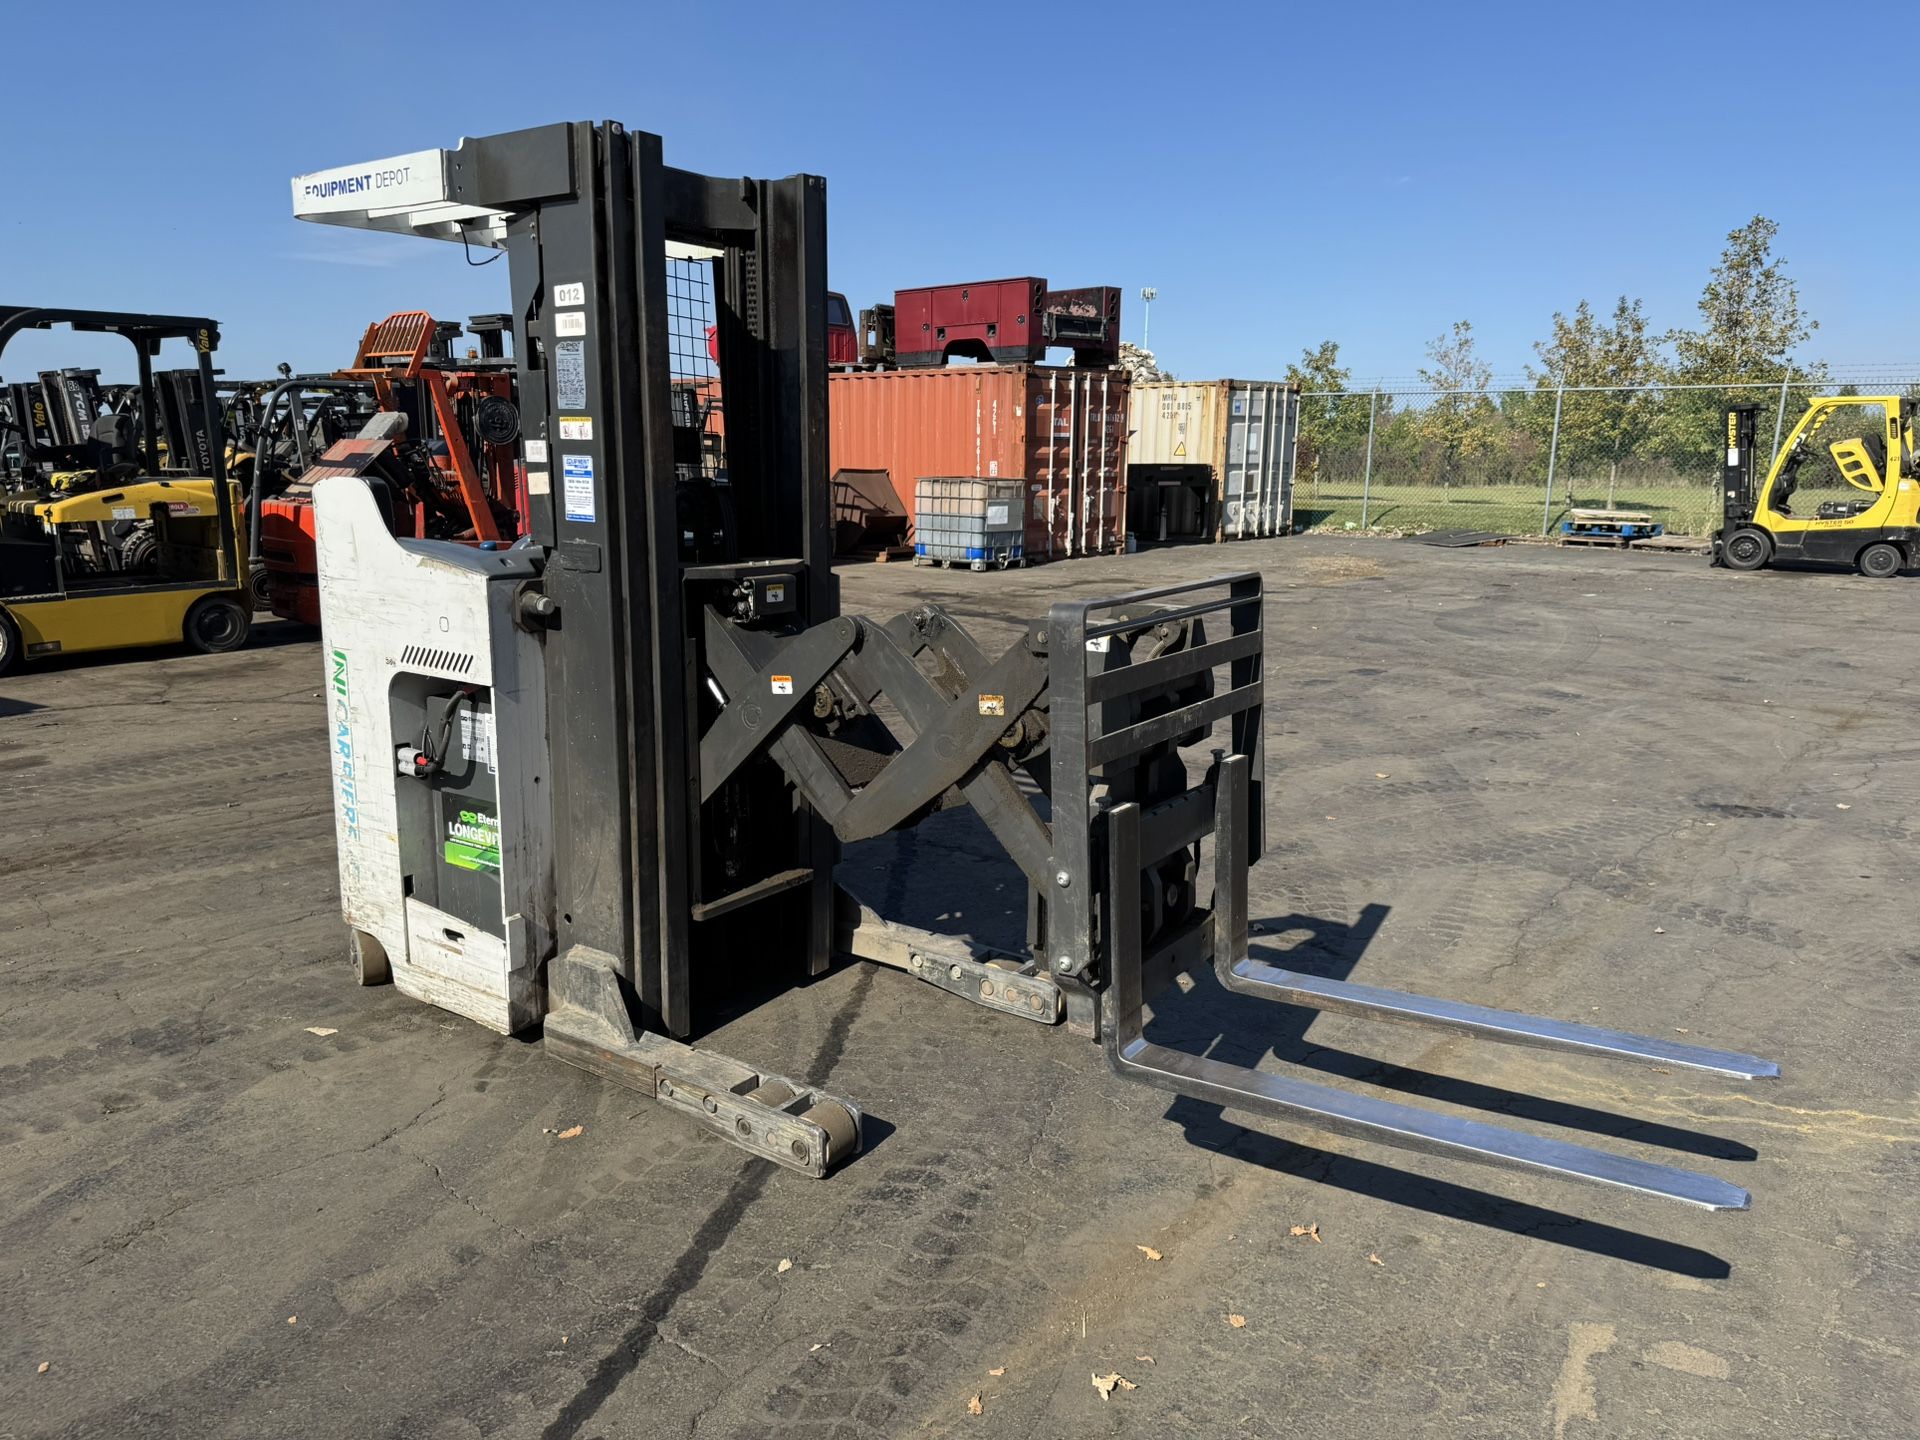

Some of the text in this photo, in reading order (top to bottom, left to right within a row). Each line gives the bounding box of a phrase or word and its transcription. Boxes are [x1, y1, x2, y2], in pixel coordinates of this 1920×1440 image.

[375, 166, 411, 189] DEPOT
[559, 287, 581, 302] 012
[199, 328, 210, 354] Yale
[33, 401, 47, 428] Yale
[73, 391, 88, 421] TCM
[1728, 411, 1737, 449] HYSTER
[196, 429, 212, 472] TOYOTA
